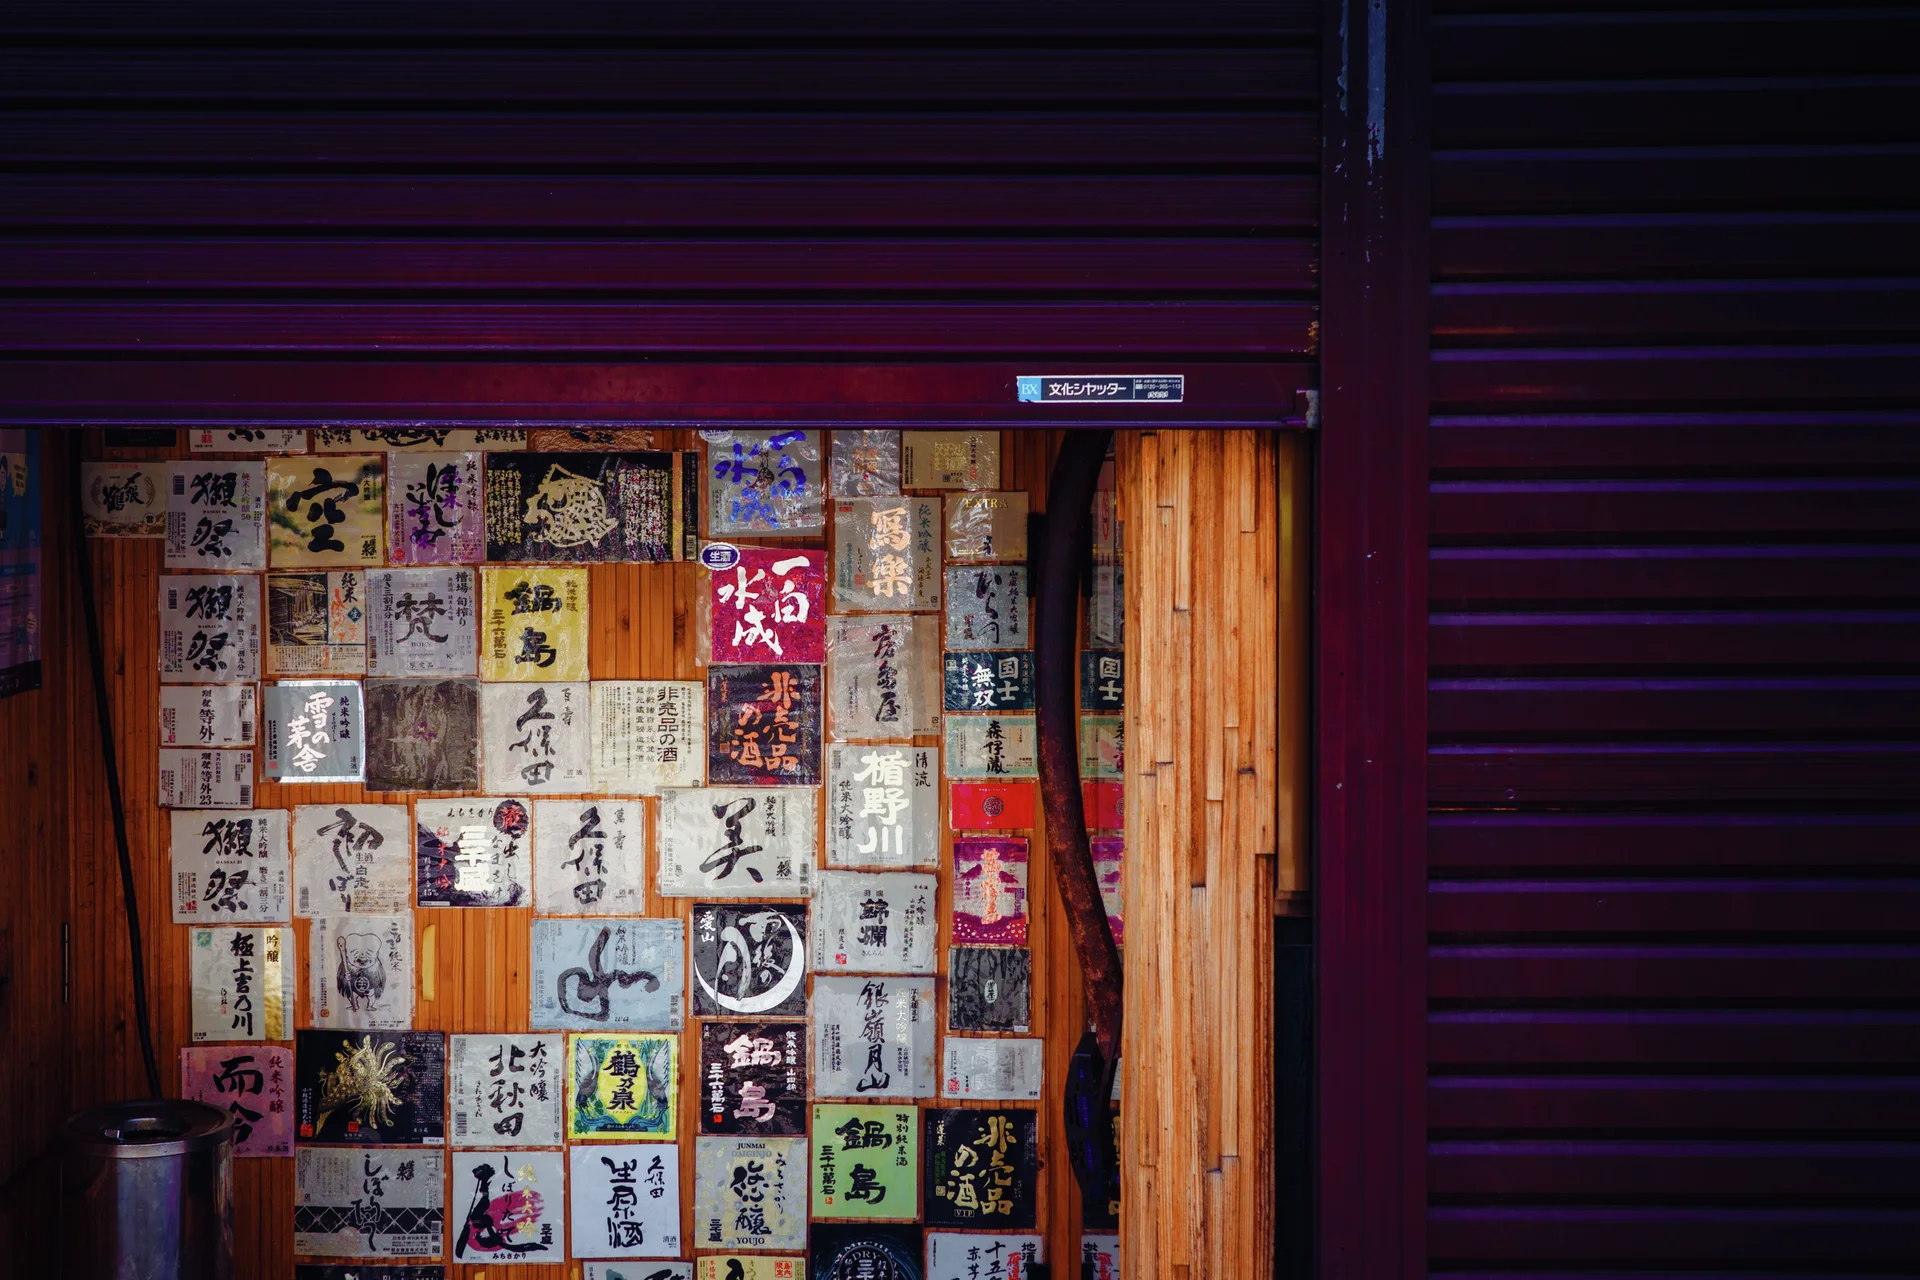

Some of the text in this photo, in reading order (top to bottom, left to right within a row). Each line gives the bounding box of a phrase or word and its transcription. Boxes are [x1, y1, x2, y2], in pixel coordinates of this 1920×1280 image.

[1022, 383, 1038, 395] BX
[191, 472, 240, 557] 獺祭
[286, 467, 360, 553] 空
[965, 498, 1007, 509] EXTRA
[341, 573, 357, 603] 純米
[185, 585, 234, 670] 獺祭
[502, 581, 561, 668] 鍋島
[971, 664, 998, 708] 無双
[996, 656, 1020, 702] 国士
[340, 696, 351, 739] 純米吟醸
[508, 687, 555, 786] 久保田
[657, 687, 679, 762] 非売品の酒
[915, 752, 931, 787] 清流
[838, 780, 854, 840] 純米大吟醸
[852, 750, 912, 855] 楯野川
[202, 818, 257, 914] 獺祭
[354, 865, 370, 889] 白老
[561, 806, 608, 905] 久保田
[266, 935, 279, 963] 吟醸
[700, 905, 717, 938] 愛山
[230, 931, 254, 1037] 極上吉乃川
[856, 980, 890, 1093] 銀嶺月山
[213, 1055, 264, 1145] 而今
[269, 1056, 284, 1114] 純米吟醸
[488, 1044, 525, 1137] 北秋田
[529, 1040, 549, 1101] 大吟醸
[724, 1034, 782, 1123] 鍋島
[644, 1155, 665, 1198] 久保田
[732, 1150, 772, 1159] DAIGINJO
[820, 1145, 836, 1195] 三十六萬石
[835, 1117, 893, 1205] 鍋島
[946, 1144, 979, 1210] の酒
[973, 1115, 1017, 1216] 非売品
[601, 1156, 644, 1249] 生原酒
[737, 1237, 765, 1246] YOUJO
[852, 1251, 880, 1261] DRY
